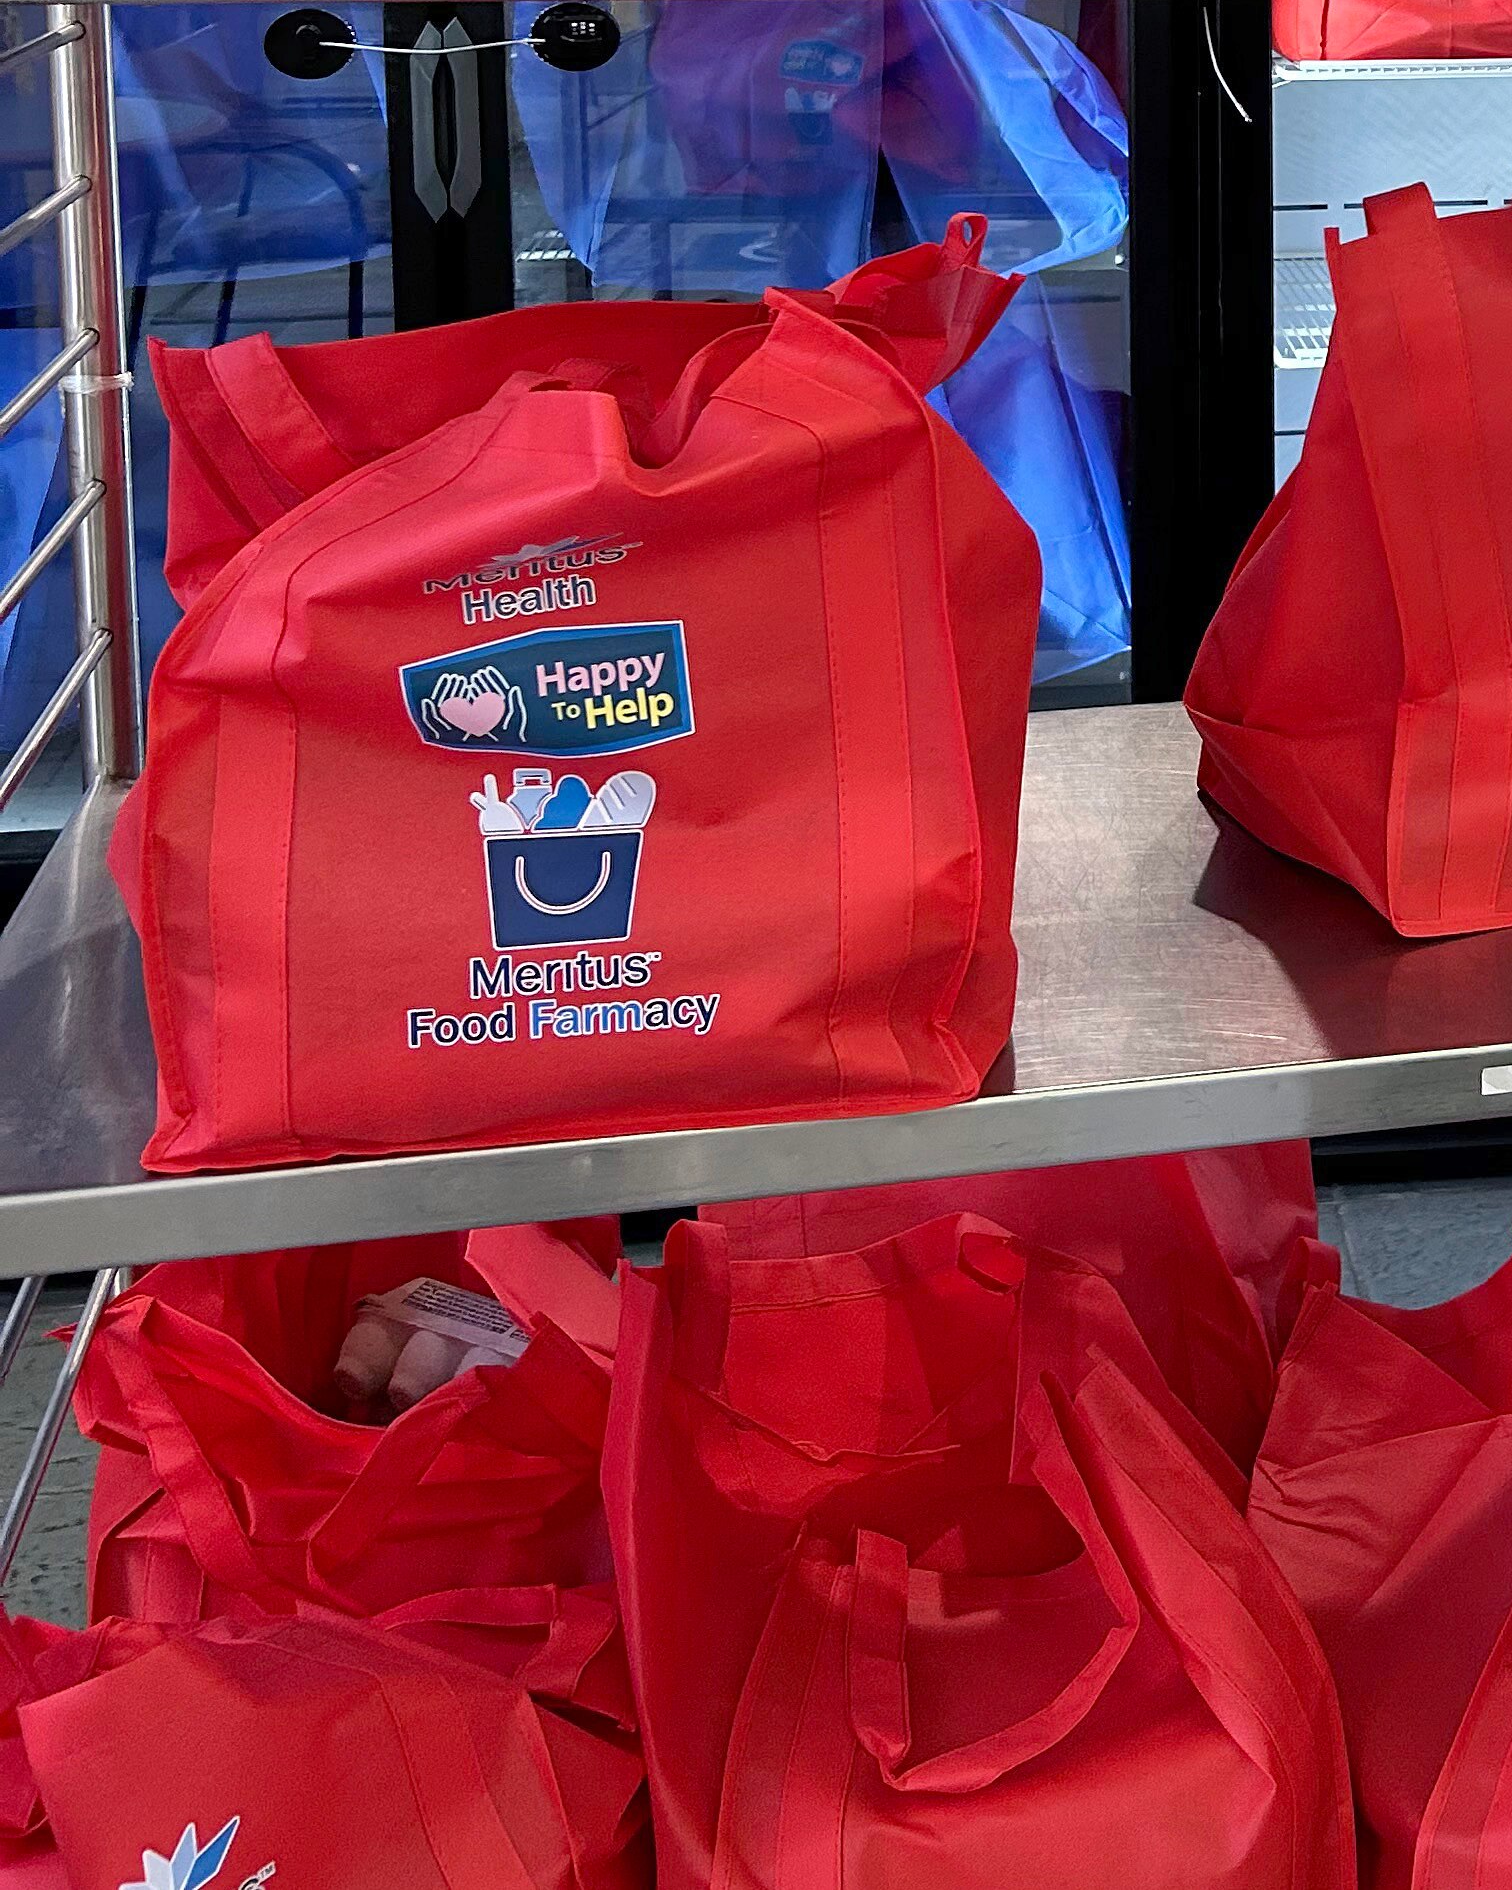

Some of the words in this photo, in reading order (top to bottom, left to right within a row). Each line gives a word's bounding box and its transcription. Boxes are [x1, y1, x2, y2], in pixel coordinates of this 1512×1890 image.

[463, 574, 596, 625] Health
[536, 653, 665, 696] Happy
[551, 702, 581, 720] To
[585, 687, 675, 729] Help
[408, 1001, 516, 1048] Food
[530, 992, 721, 1040] Farmacy
